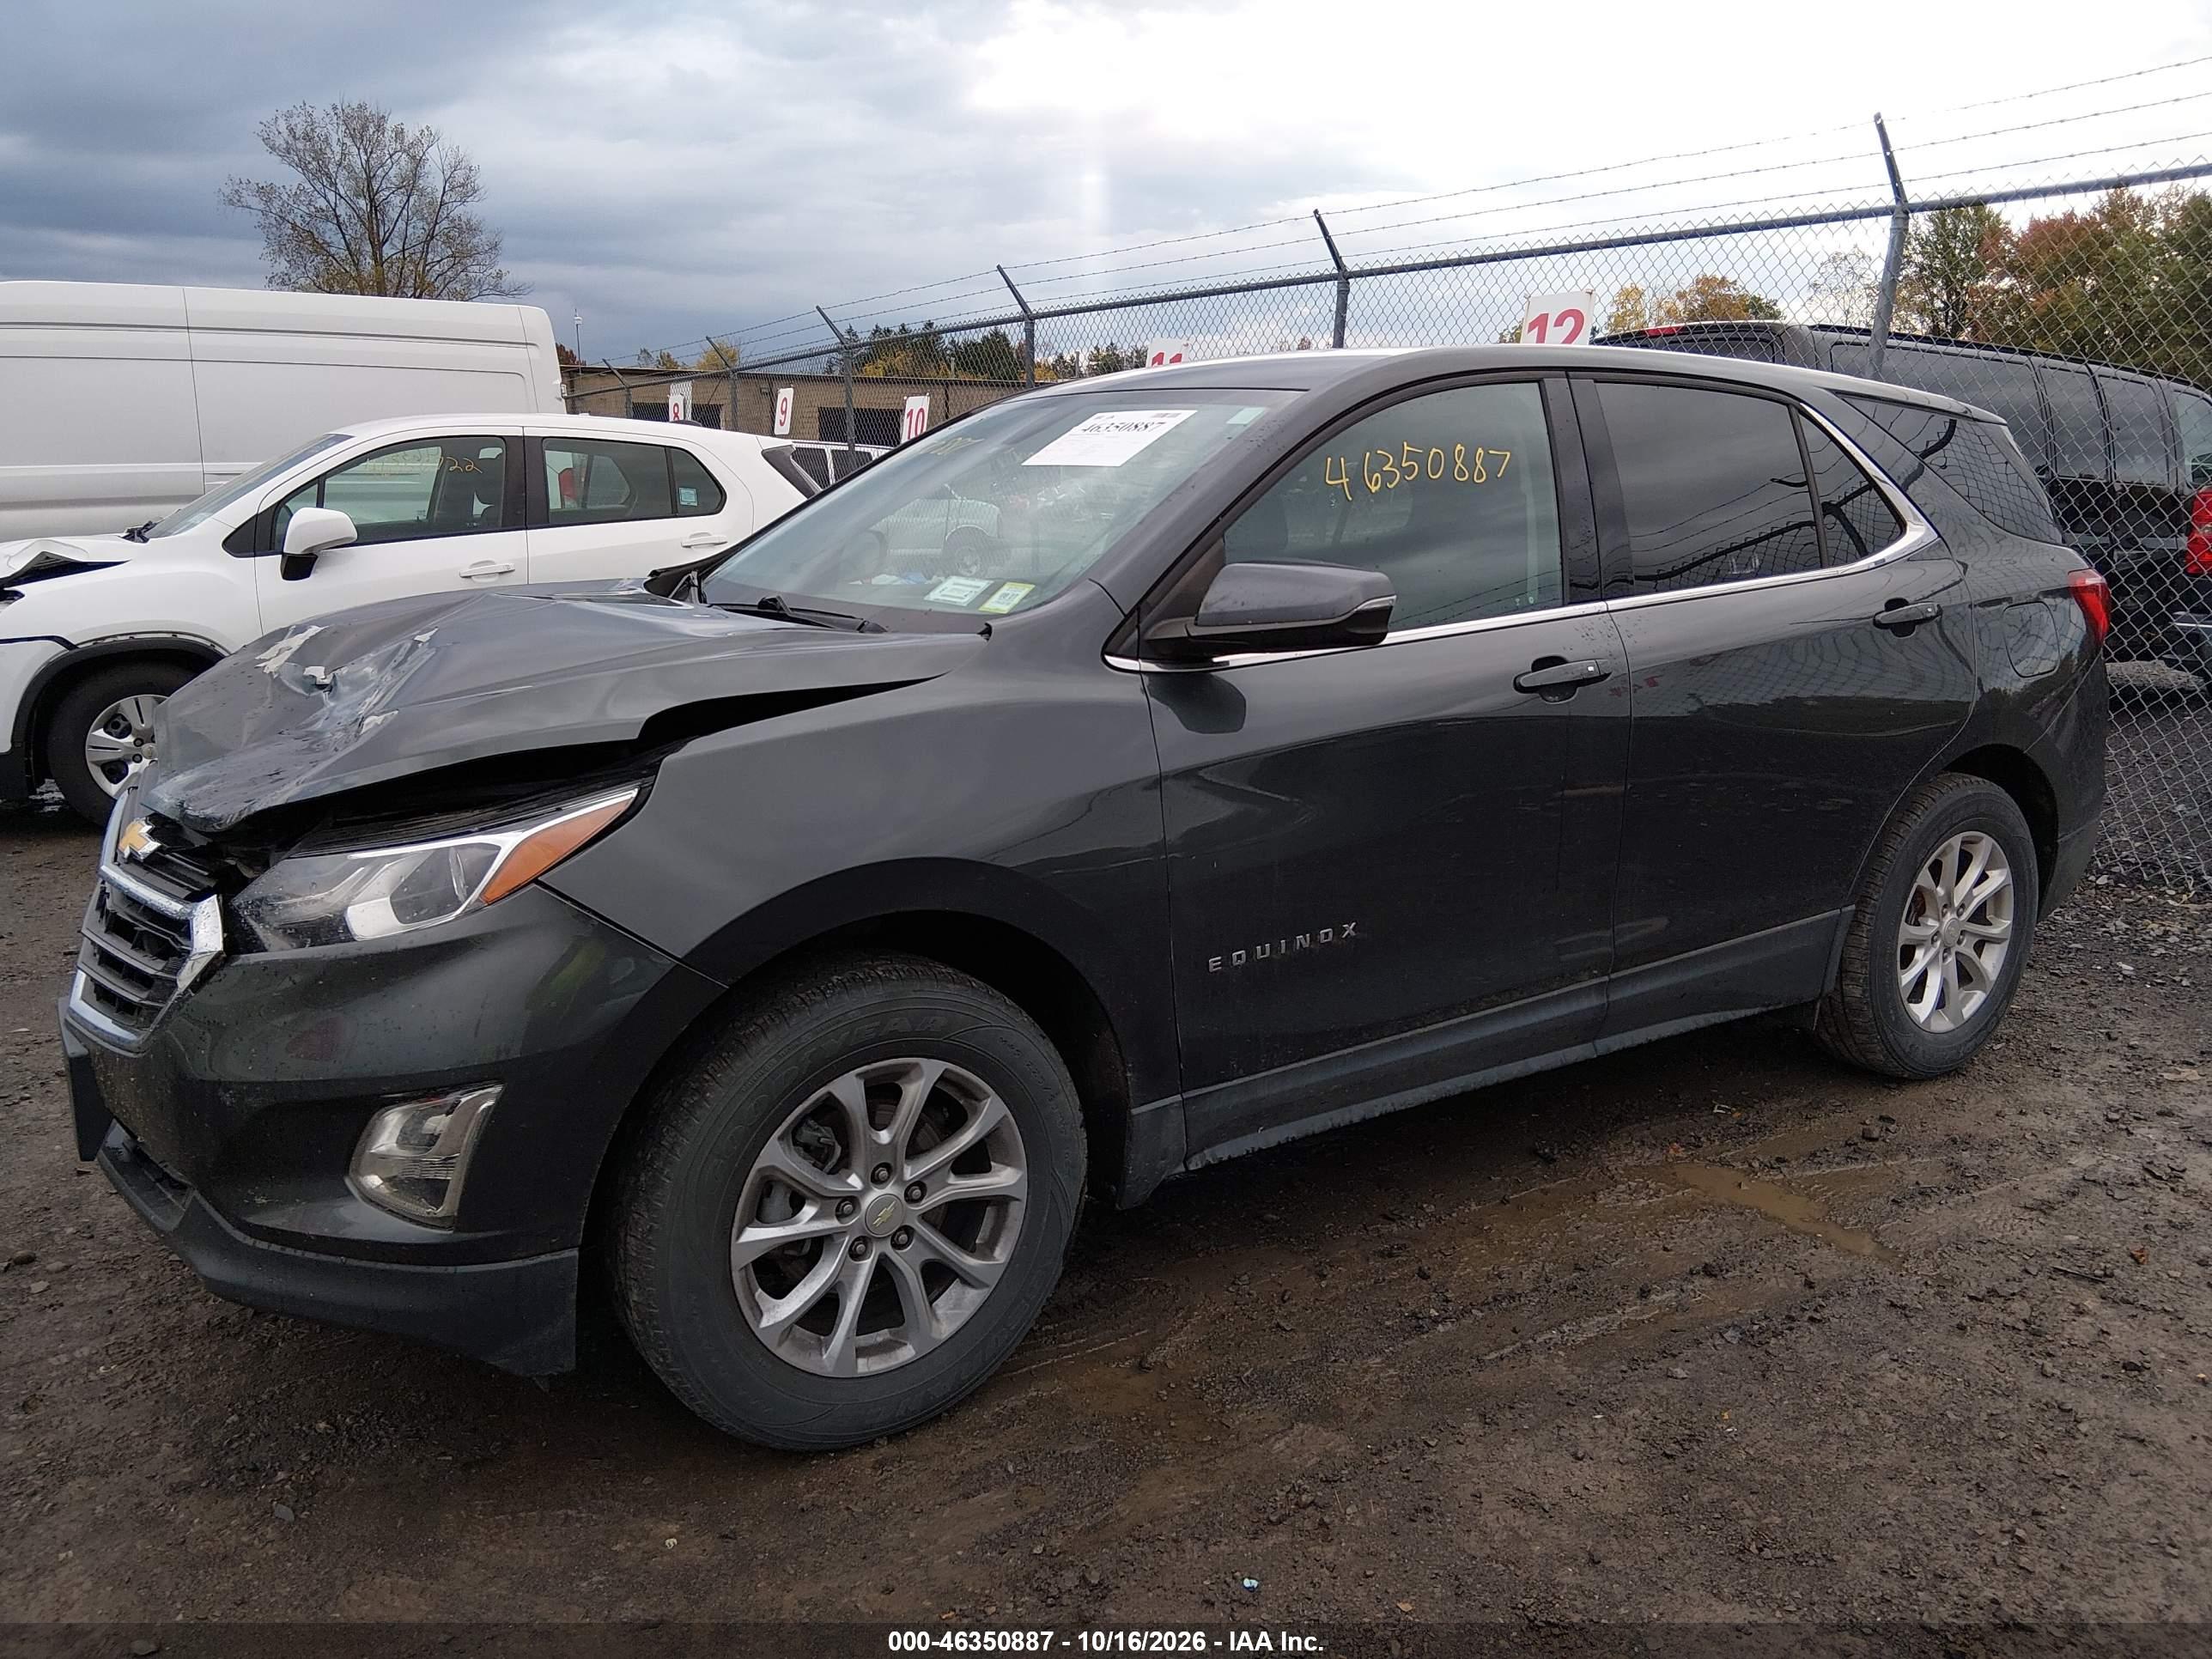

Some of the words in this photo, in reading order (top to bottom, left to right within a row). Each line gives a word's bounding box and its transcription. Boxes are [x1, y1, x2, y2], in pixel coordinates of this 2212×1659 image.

[1527, 308, 1585, 344] 12
[672, 403, 680, 422] 8
[779, 397, 787, 427] 9
[906, 407, 925, 440] 10
[1325, 441, 1511, 501] 46350887
[1208, 921, 1358, 973] EQUINOX
